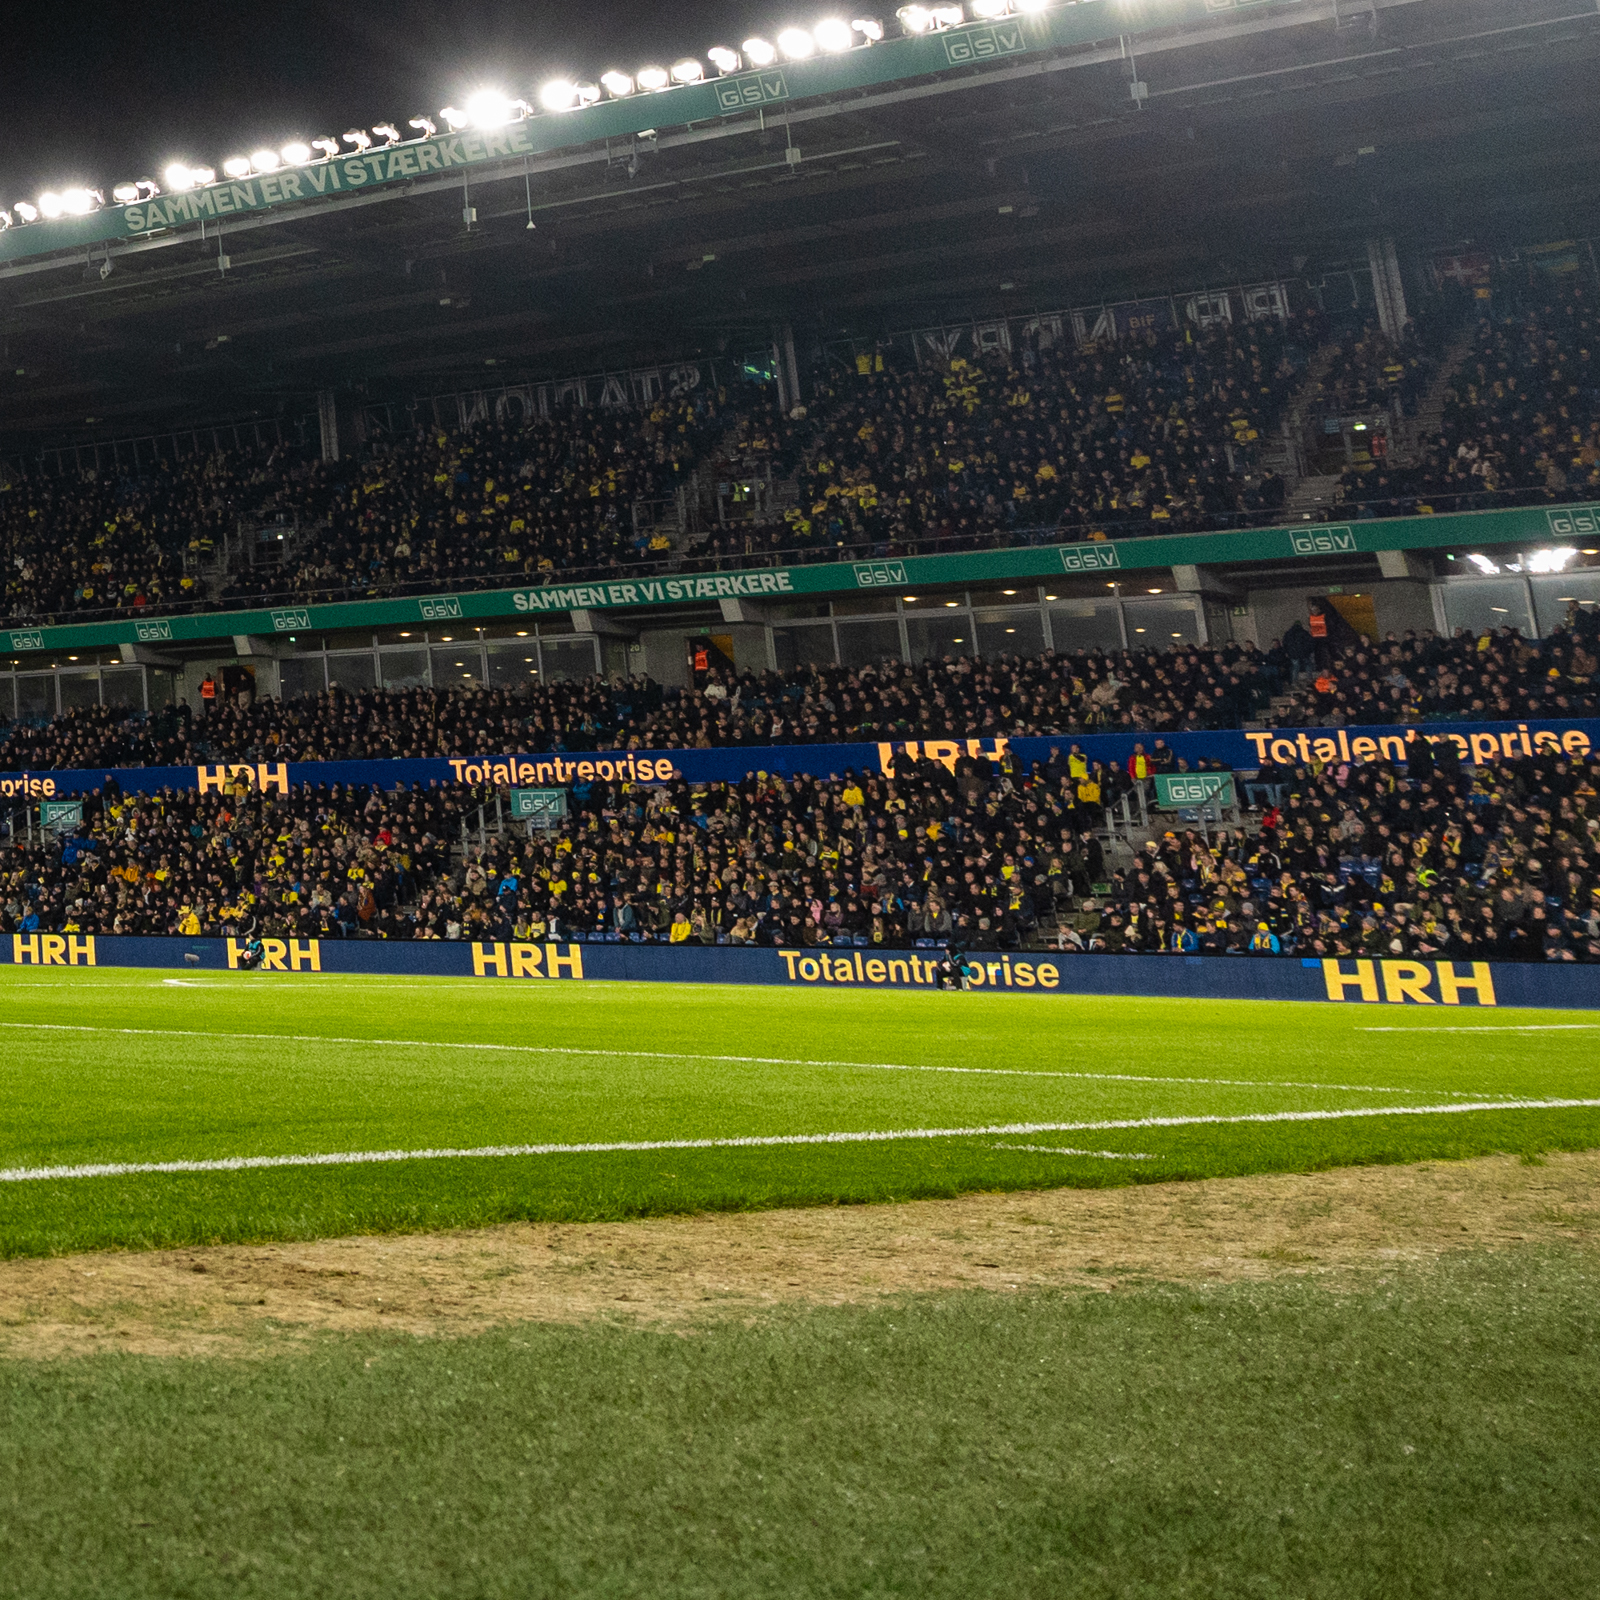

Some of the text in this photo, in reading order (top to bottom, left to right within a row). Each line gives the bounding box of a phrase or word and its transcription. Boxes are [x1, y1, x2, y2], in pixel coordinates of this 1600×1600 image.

[949, 31, 1018, 61] GSV
[721, 80, 782, 107] GSV
[124, 124, 534, 231] SAMMEN ER VI STÆRKERE
[1295, 532, 1352, 552] GSV
[1064, 551, 1116, 570] GSV
[858, 566, 905, 586] GSV
[513, 571, 794, 612] SAMMEN ER VI STÆRKERE
[274, 613, 309, 630] GSV
[422, 602, 458, 619] GSV
[11, 635, 42, 650] GSV
[138, 624, 170, 640] GSV
[629, 644, 640, 652] 20
[449, 753, 674, 785] Totalentreprise
[1171, 784, 1218, 799] GSV
[12, 934, 97, 966] HRH
[471, 941, 584, 980] HRH
[779, 950, 1060, 988] Totalentrprise
[1322, 960, 1497, 1007] HRH
